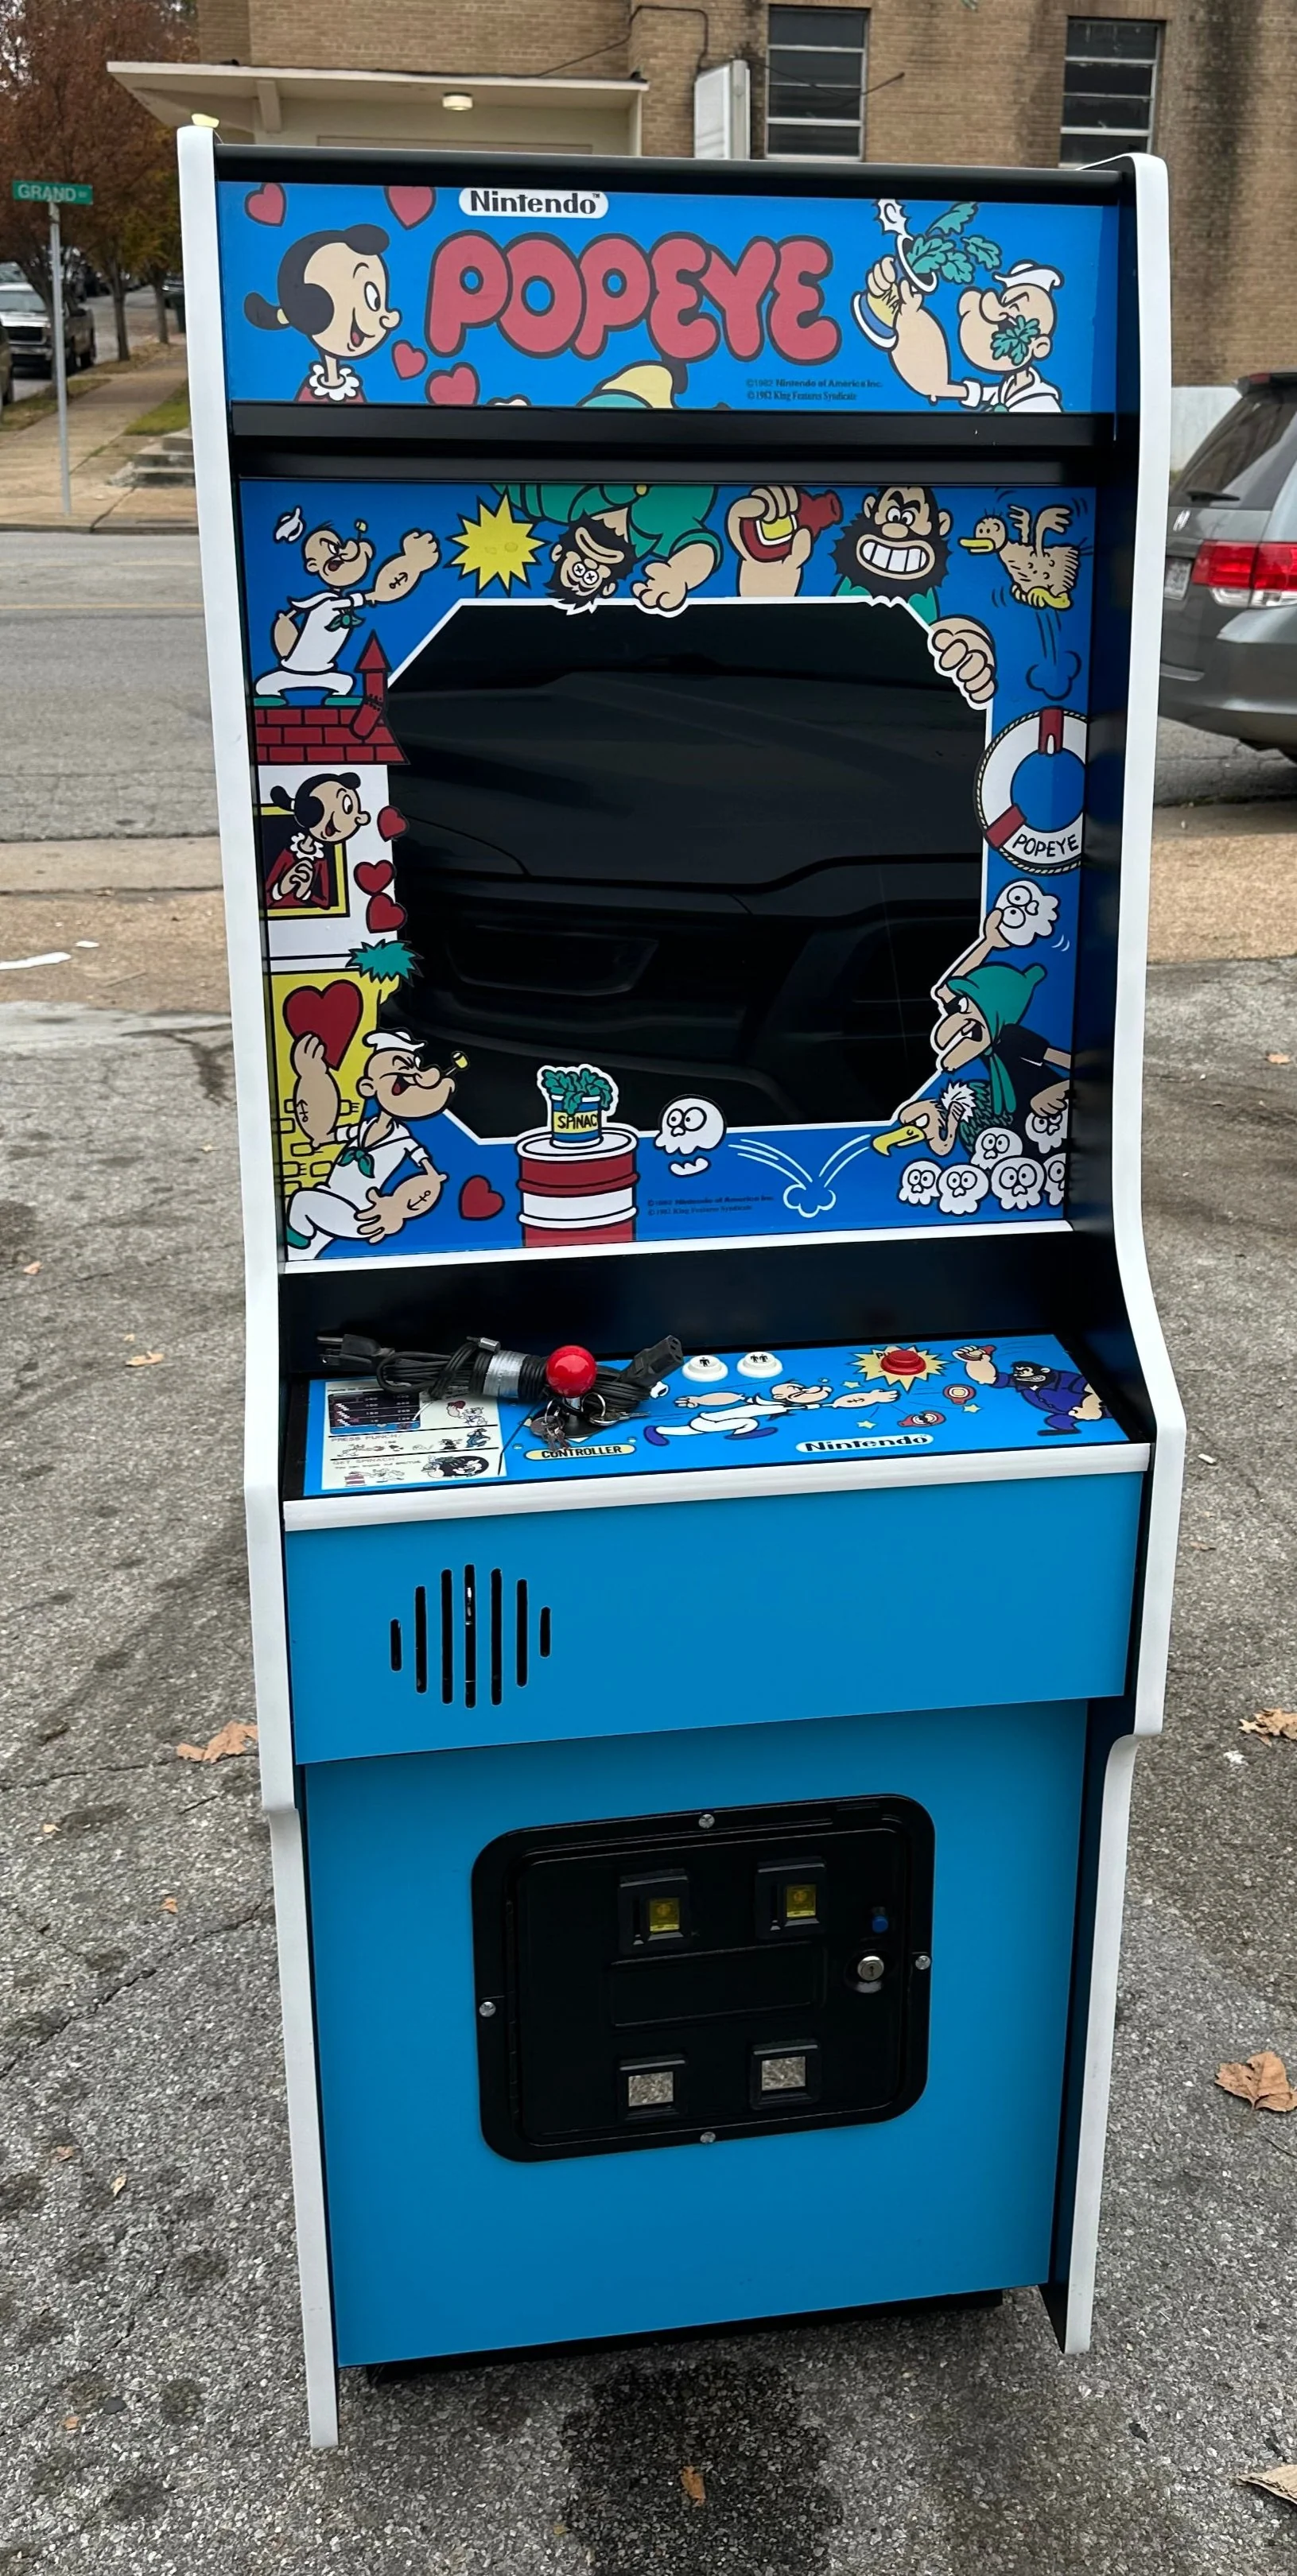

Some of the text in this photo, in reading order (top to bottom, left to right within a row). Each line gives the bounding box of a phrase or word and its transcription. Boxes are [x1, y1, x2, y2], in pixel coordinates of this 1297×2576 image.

[17, 184, 76, 202] GRAND
[471, 190, 596, 215] Nintendo
[424, 229, 842, 366] POPEYE
[775, 378, 816, 387] Nintendo
[1012, 834, 1079, 857] POPEYE
[541, 1445, 623, 1459] CONTROLLER
[805, 1436, 927, 1452] Nintendo
